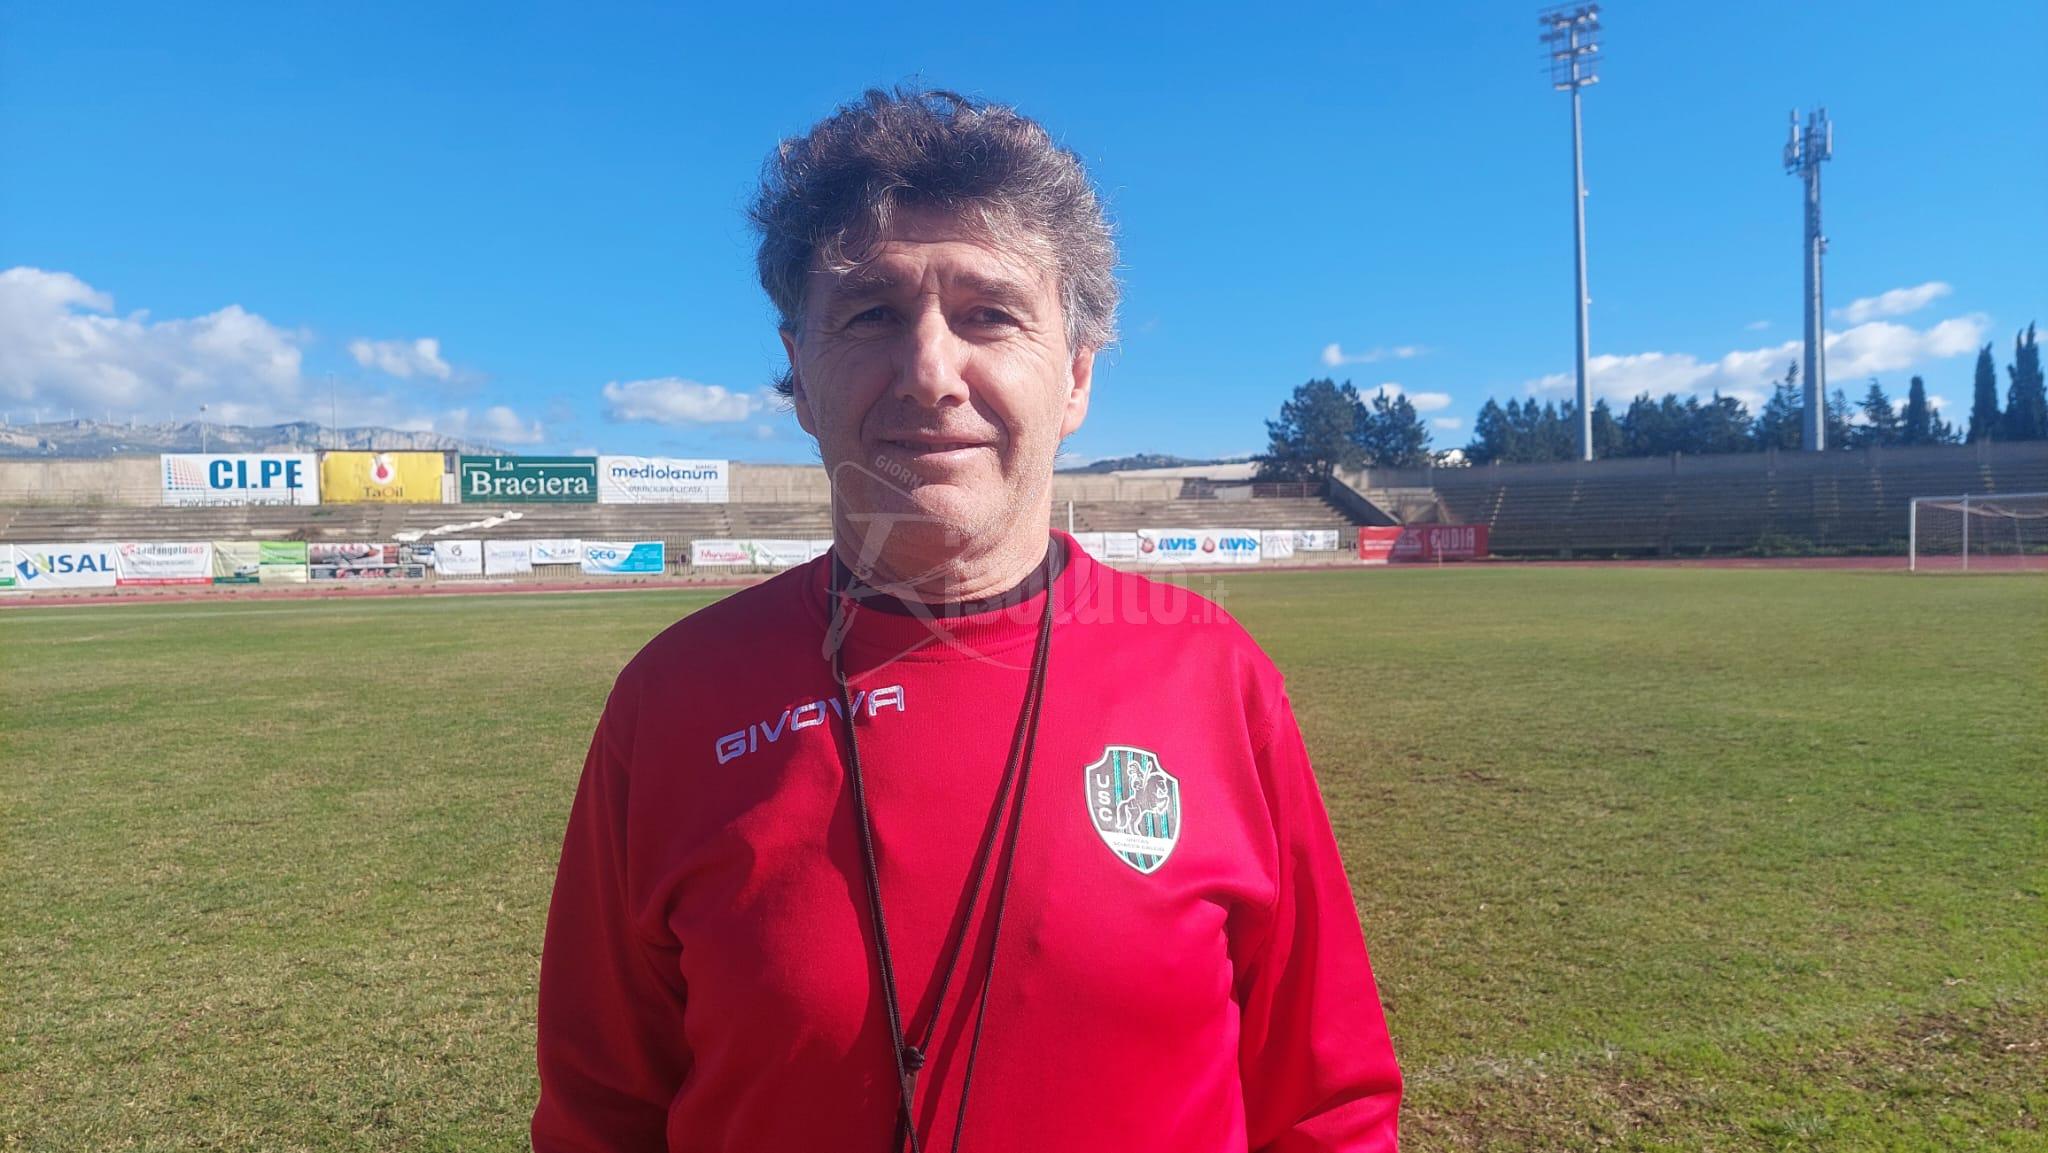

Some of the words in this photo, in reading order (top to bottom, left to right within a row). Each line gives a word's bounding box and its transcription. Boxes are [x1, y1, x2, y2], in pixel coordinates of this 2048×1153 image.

[209, 460, 303, 489] CI.PE
[495, 459, 513, 471] La
[612, 464, 718, 480] mediolanum
[470, 470, 589, 496] Braciera
[1158, 538, 1197, 551] AVIS
[1218, 538, 1257, 551] AVIS
[715, 684, 906, 765] GIVOVA
[1096, 773, 1113, 822] USC
